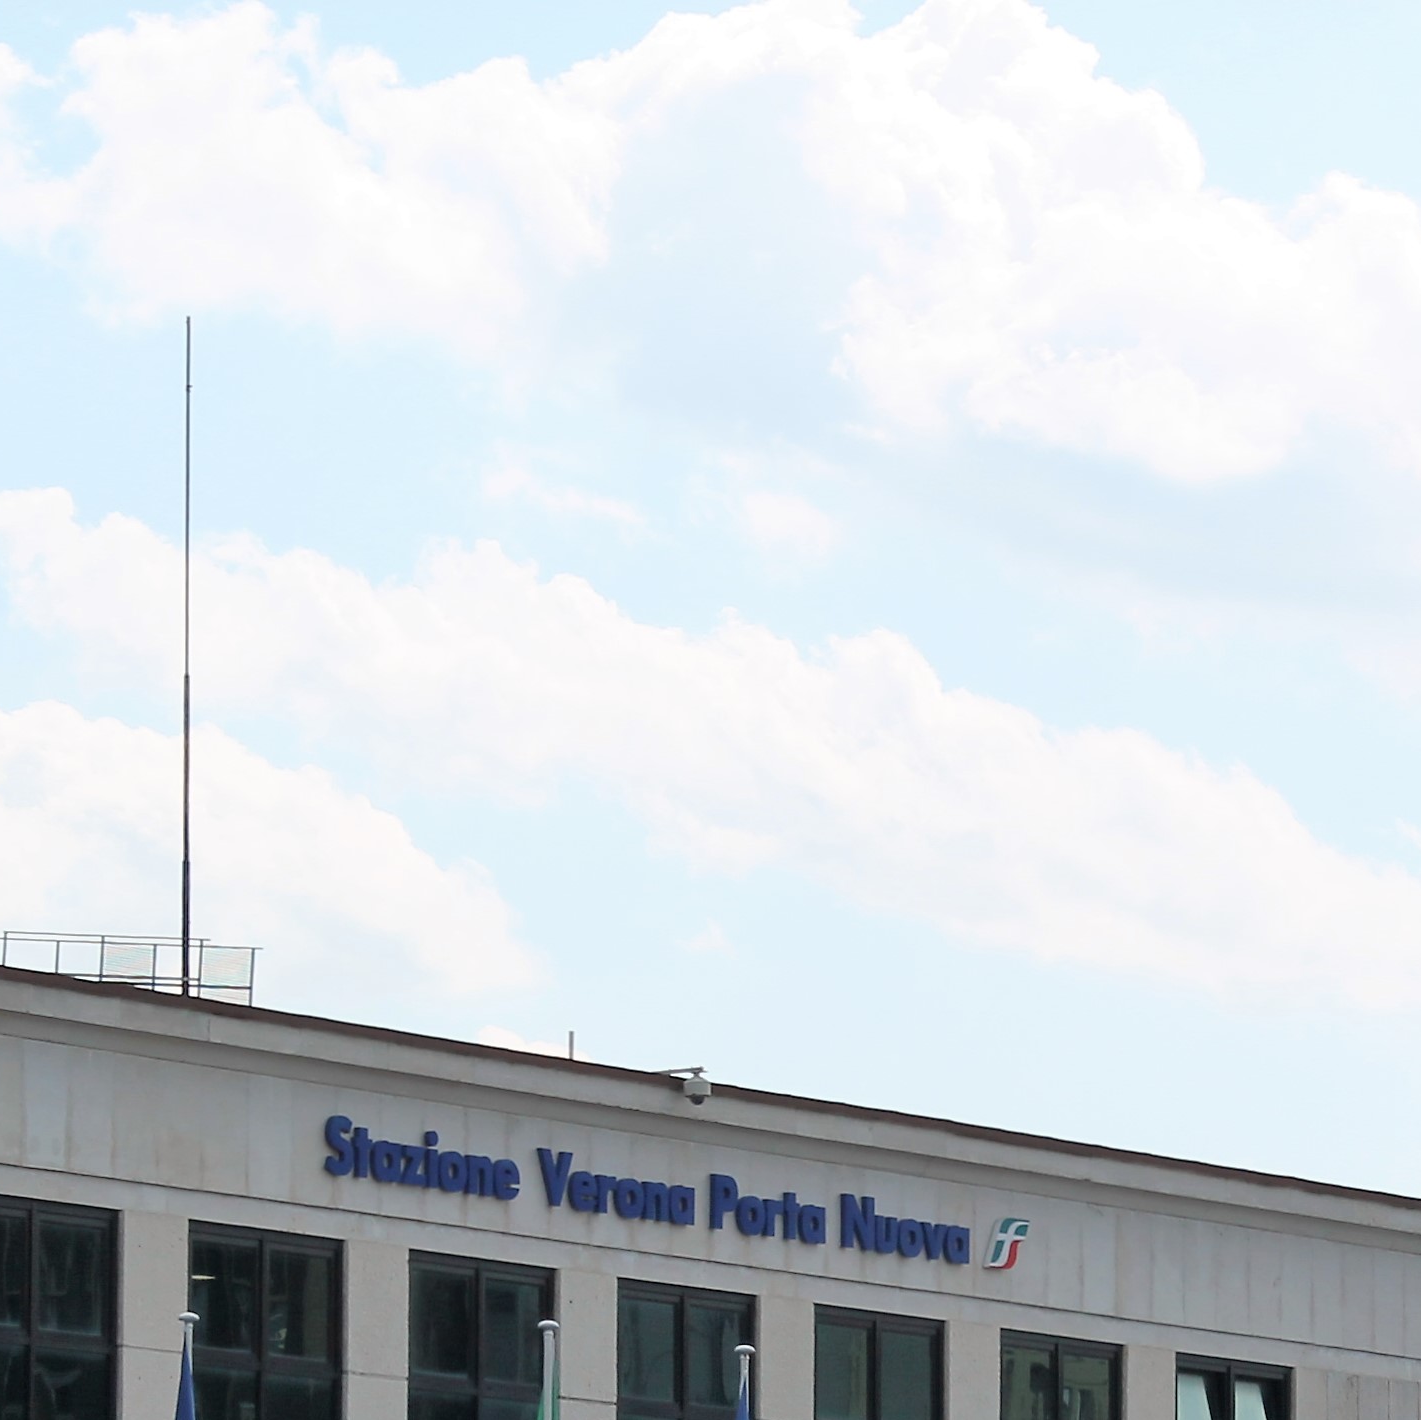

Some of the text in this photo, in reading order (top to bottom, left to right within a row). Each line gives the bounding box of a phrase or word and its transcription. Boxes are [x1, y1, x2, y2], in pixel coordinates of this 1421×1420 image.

[324, 1115, 970, 1265] Stazione Verona Porta Nuova
